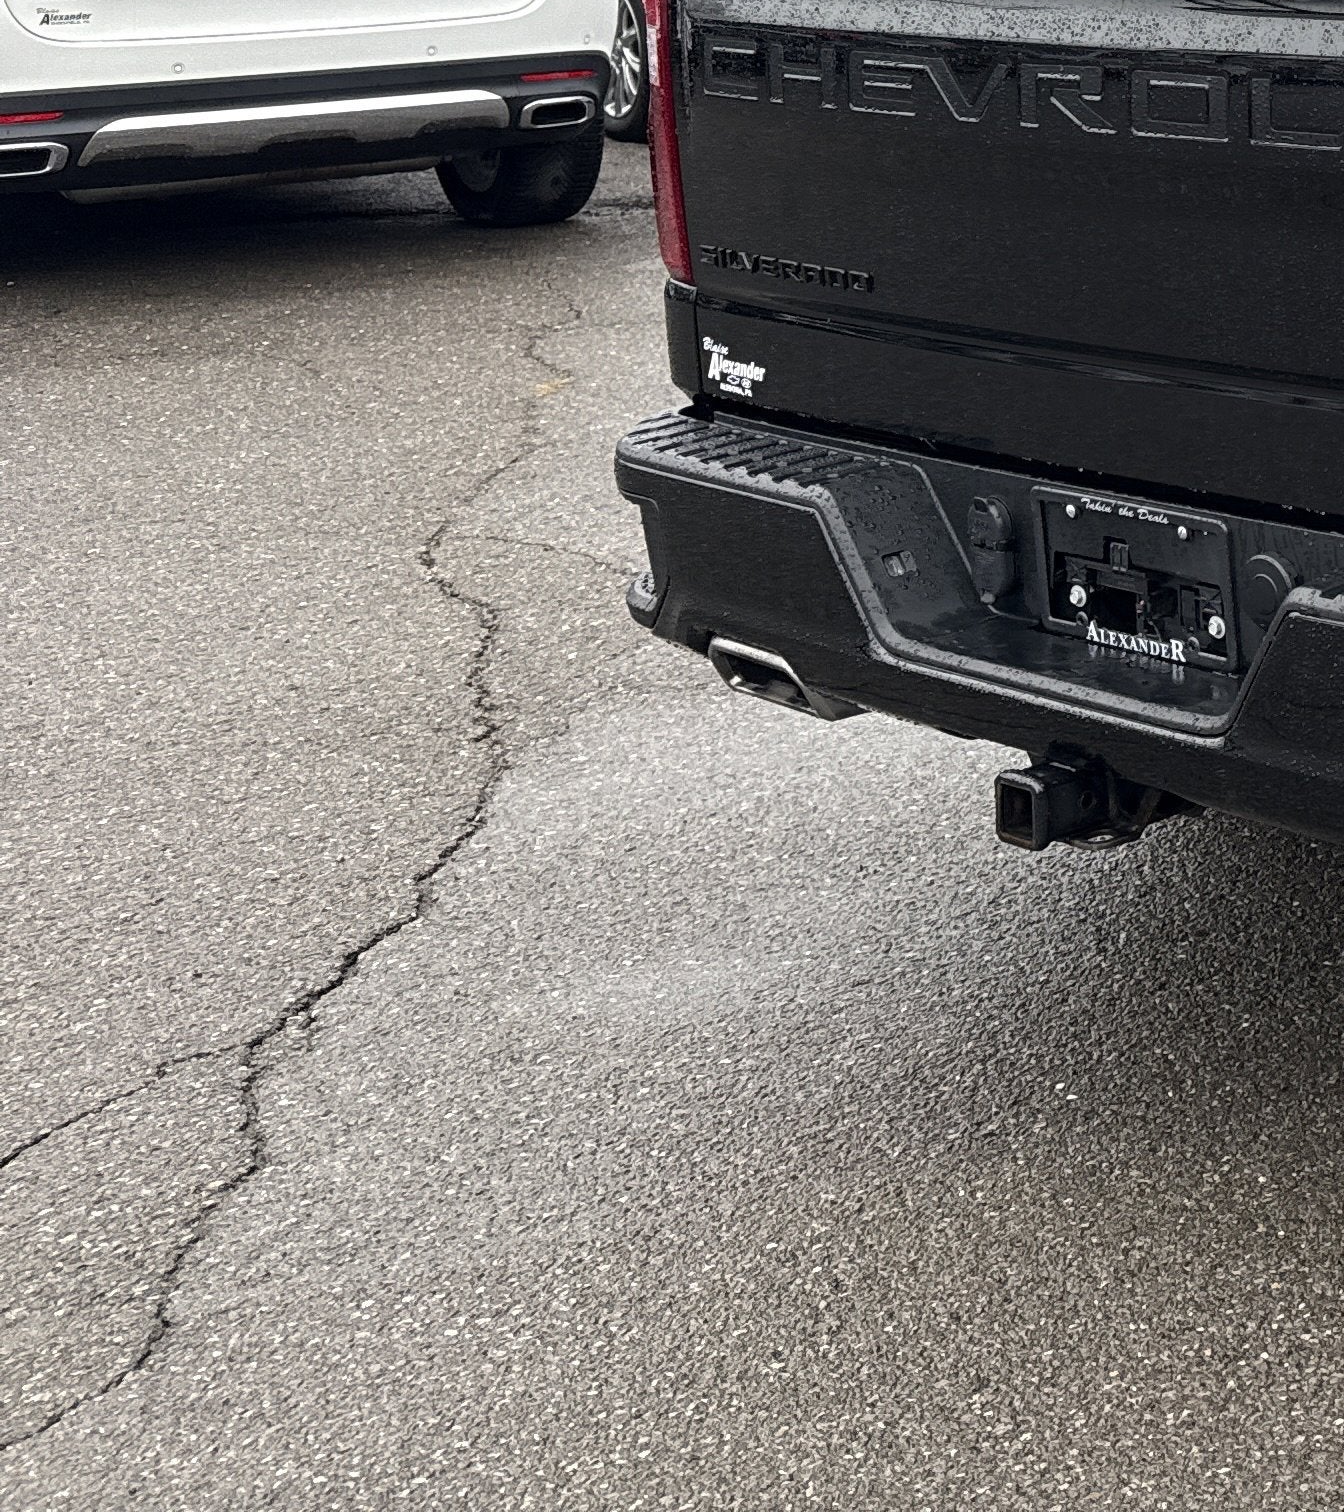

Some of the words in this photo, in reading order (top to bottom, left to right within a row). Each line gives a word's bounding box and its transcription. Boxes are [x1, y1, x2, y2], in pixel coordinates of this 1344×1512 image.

[39, 12, 92, 26] Alexander
[699, 244, 875, 293] SILVERADO
[707, 352, 766, 382] Alexander
[1136, 508, 1170, 525] Deals
